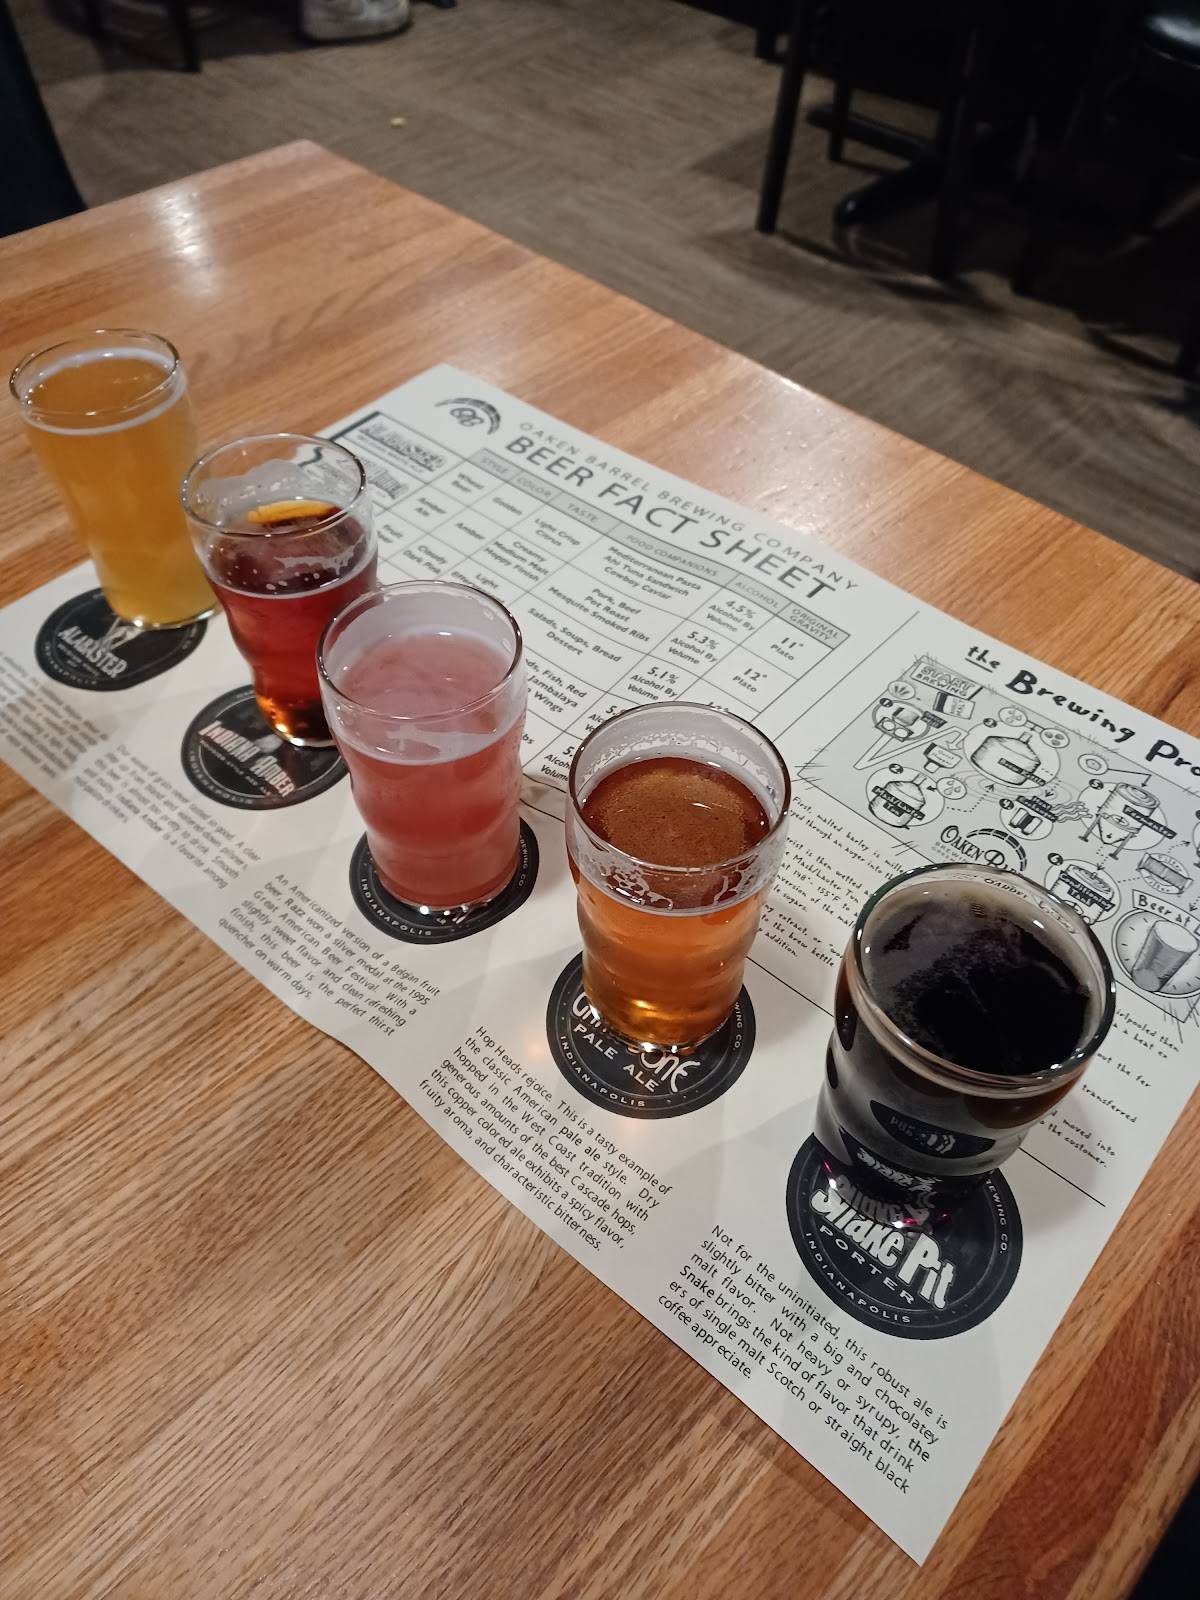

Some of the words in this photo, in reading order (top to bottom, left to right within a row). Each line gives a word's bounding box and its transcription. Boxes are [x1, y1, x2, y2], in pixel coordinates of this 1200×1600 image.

[480, 457, 509, 474] STYLE
[517, 477, 552, 498] COLOR
[520, 423, 579, 455] OAKEN
[585, 456, 649, 491] BARREL
[657, 490, 744, 531] BREWING
[754, 533, 858, 589] COMPANY
[505, 436, 594, 487] BEER
[598, 483, 699, 534] FACT
[699, 530, 836, 598] SHEET
[568, 503, 598, 522] TASTE
[535, 518, 557, 532] Light
[558, 531, 580, 546] Crisp
[608, 546, 674, 580] Mediterranean
[675, 577, 701, 590] Pasta
[626, 535, 654, 550] FOOD
[654, 549, 717, 576] COMPANIONS
[604, 556, 620, 566] Ahi
[623, 564, 644, 578] Tuna
[646, 576, 689, 596] Sandwich
[604, 567, 640, 587] Cowboy
[641, 585, 671, 599] Caviar
[734, 582, 778, 608] ALCOHOL
[548, 587, 589, 612] Mesquite
[590, 611, 629, 632] Smoked
[629, 630, 650, 642] Ribs
[584, 596, 602, 608] Pot
[603, 606, 630, 622] Roast
[592, 588, 615, 605] Pork,
[618, 602, 641, 614] Beef
[708, 604, 743, 623] Alcohol
[742, 621, 755, 631] By
[726, 601, 755, 618] 4.5%
[528, 608, 557, 629] Salads,
[560, 627, 589, 648] Soups,
[592, 645, 622, 662] Bread
[687, 631, 716, 649] 5.3%
[706, 613, 738, 632] Volume
[789, 615, 830, 640] GRAVITY
[792, 609, 838, 639] ORIGINAL
[58, 626, 128, 678] ALABASTER
[546, 631, 583, 655] Dessert
[668, 647, 700, 664] Volume
[670, 637, 705, 655] Alcohol
[705, 653, 717, 662] By
[770, 644, 794, 661] Plato
[627, 684, 659, 700] Volume
[630, 675, 665, 690] Alcohol
[664, 688, 678, 697] By
[647, 666, 679, 684] 5.1%
[732, 675, 757, 692] Plato
[915, 673, 968, 697] BREWING
[921, 666, 975, 691] START
[968, 646, 1000, 669] the
[1005, 670, 1136, 743] Brewing
[198, 720, 261, 763] INDIANA
[250, 755, 296, 797] AMBER
[817, 814, 843, 832] malted
[846, 832, 869, 851] barley
[361, 878, 432, 936] INDIANAPOLIS
[1138, 894, 1172, 916] Beer
[1175, 914, 1192, 927] at
[254, 891, 279, 913] Great
[278, 913, 320, 947] American
[321, 947, 342, 965] Beer
[386, 992, 407, 1008] With
[560, 1035, 645, 1107] INDIANAPOLIS
[573, 1023, 618, 1059] PALE
[622, 1063, 659, 1092] ALE
[476, 1026, 495, 1048] Hop
[494, 1046, 522, 1074] Heads
[521, 1073, 552, 1102] rejoice.
[557, 1100, 578, 1122] This
[577, 1118, 587, 1130] is
[586, 1128, 594, 1136] a
[595, 1133, 618, 1155] tasty
[618, 1153, 659, 1187] example
[658, 1185, 673, 1195] of
[1082, 1084, 1137, 1123] transferred
[453, 1046, 489, 1082] hopped
[488, 1082, 499, 1095] in
[502, 1096, 518, 1112] the
[521, 1111, 546, 1136] West
[548, 1135, 576, 1162] Coast
[579, 1161, 621, 1200] tradition
[626, 1200, 648, 1221] with
[465, 1037, 480, 1055] the
[482, 1057, 511, 1085] classic
[513, 1086, 558, 1126] American
[558, 1126, 582, 1146] pale
[584, 1146, 600, 1161] ale
[602, 1161, 627, 1185] style.
[638, 1188, 660, 1209] Dry
[1063, 1119, 1092, 1139] moved
[1097, 1140, 1115, 1156] into
[1048, 1123, 1062, 1136] the
[1064, 1137, 1106, 1167] customer.
[1000, 1233, 1008, 1254] CO.
[805, 1232, 912, 1324] INDIANAPOLIS
[819, 1225, 915, 1304] PORTER
[898, 1233, 956, 1310] Pit
[659, 1295, 692, 1326] coffee
[691, 1323, 751, 1379] appreciate.
[701, 1240, 742, 1275] slightly
[745, 1273, 776, 1303] bitter
[781, 1306, 806, 1332] with
[810, 1333, 819, 1342] a
[823, 1341, 844, 1365] big
[847, 1364, 872, 1387] and
[875, 1388, 939, 1445] chocolatey
[711, 1225, 733, 1247] Not
[735, 1244, 752, 1261] for
[756, 1263, 775, 1282] the
[778, 1282, 840, 1340] uninitiated,
[845, 1339, 867, 1361] this
[870, 1361, 910, 1398] robust
[913, 1398, 933, 1417] ale
[936, 1414, 948, 1429] is
[680, 1265, 715, 1298] Snake
[715, 1293, 751, 1329] brings
[752, 1327, 772, 1347] the
[772, 1342, 802, 1372] kind
[801, 1371, 817, 1383] of
[815, 1380, 851, 1415] flavor
[853, 1414, 878, 1441] that
[880, 1439, 914, 1473] drink
[691, 1254, 717, 1278] malt
[721, 1276, 756, 1313] flavor.
[770, 1318, 793, 1342] Not
[797, 1340, 832, 1376] heavy
[837, 1378, 851, 1391] or
[856, 1395, 900, 1439] syrupy,
[908, 1438, 930, 1462] the
[669, 1281, 688, 1298] ers
[689, 1298, 705, 1309] of
[702, 1309, 736, 1340] single
[737, 1339, 766, 1365] malt
[766, 1362, 805, 1401] Scotch
[808, 1401, 822, 1413] or
[824, 1415, 873, 1461] straight
[875, 1457, 909, 1494] black
